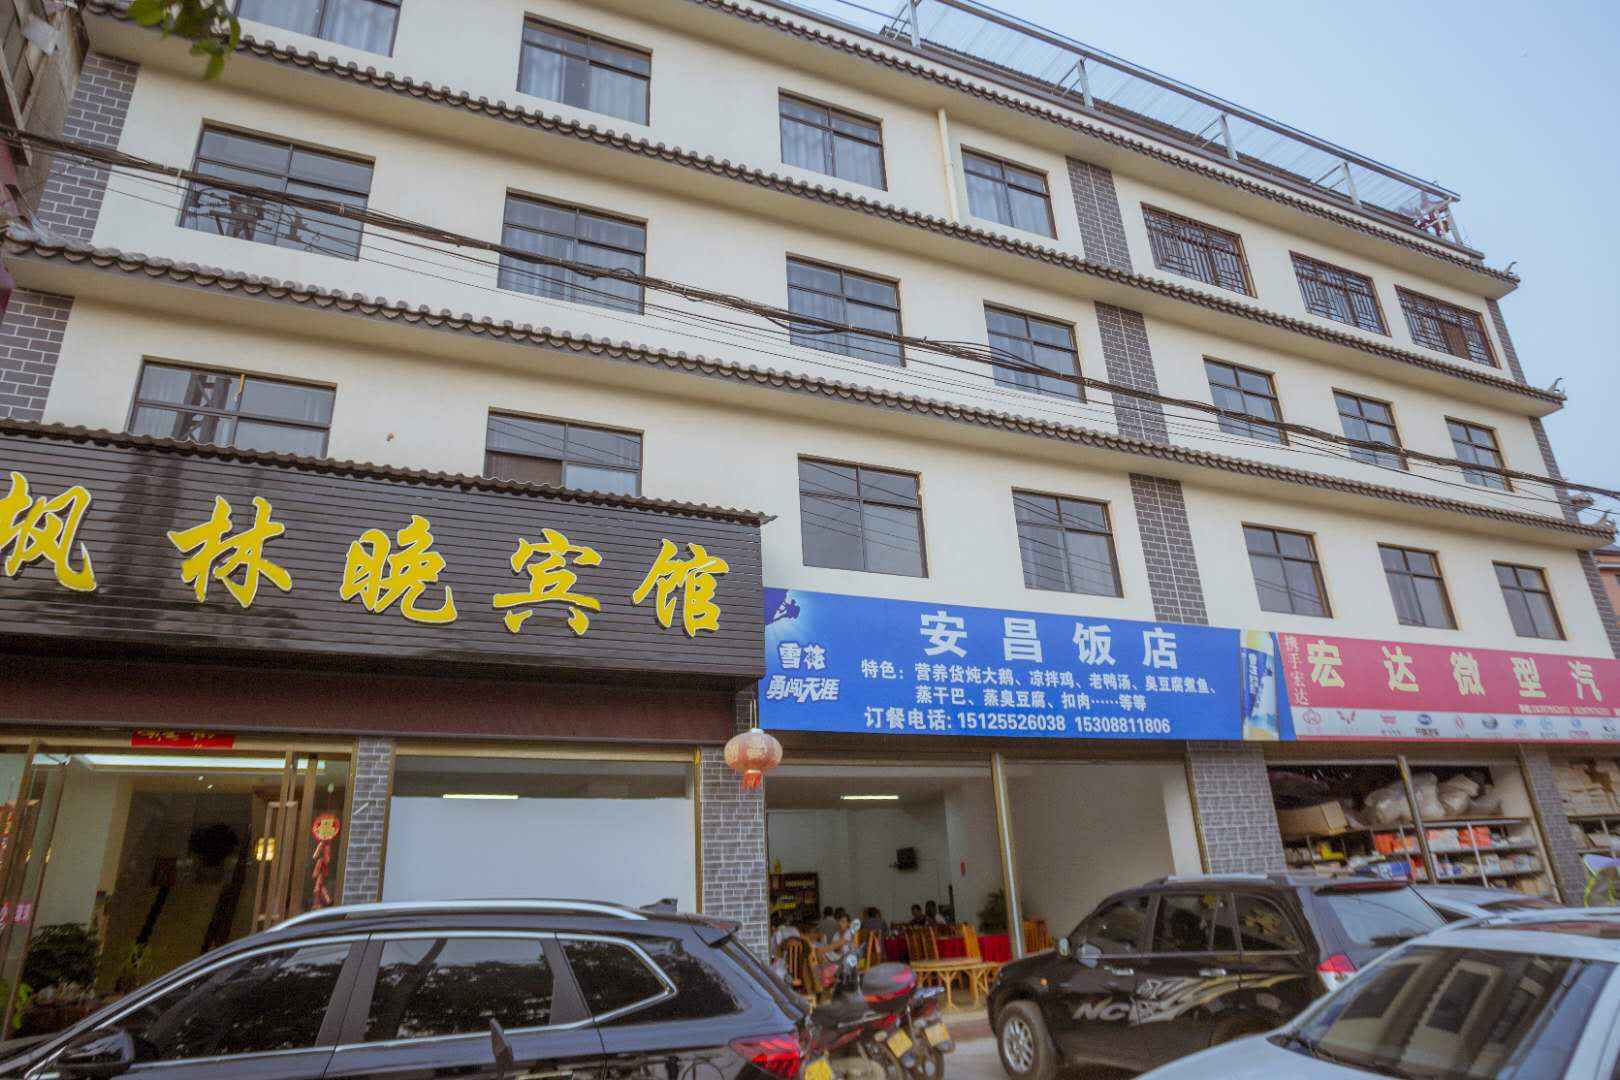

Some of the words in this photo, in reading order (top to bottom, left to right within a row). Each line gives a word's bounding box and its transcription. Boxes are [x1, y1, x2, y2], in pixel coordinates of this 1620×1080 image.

[0, 471, 730, 637] 枫林晚宾馆
[778, 642, 826, 671] 雪花
[919, 610, 1179, 670] 安昌饭店
[766, 675, 841, 703] 勇闯天涯
[1306, 640, 1602, 703] 宏达微型汽
[1074, 716, 1172, 734] 15308811806
